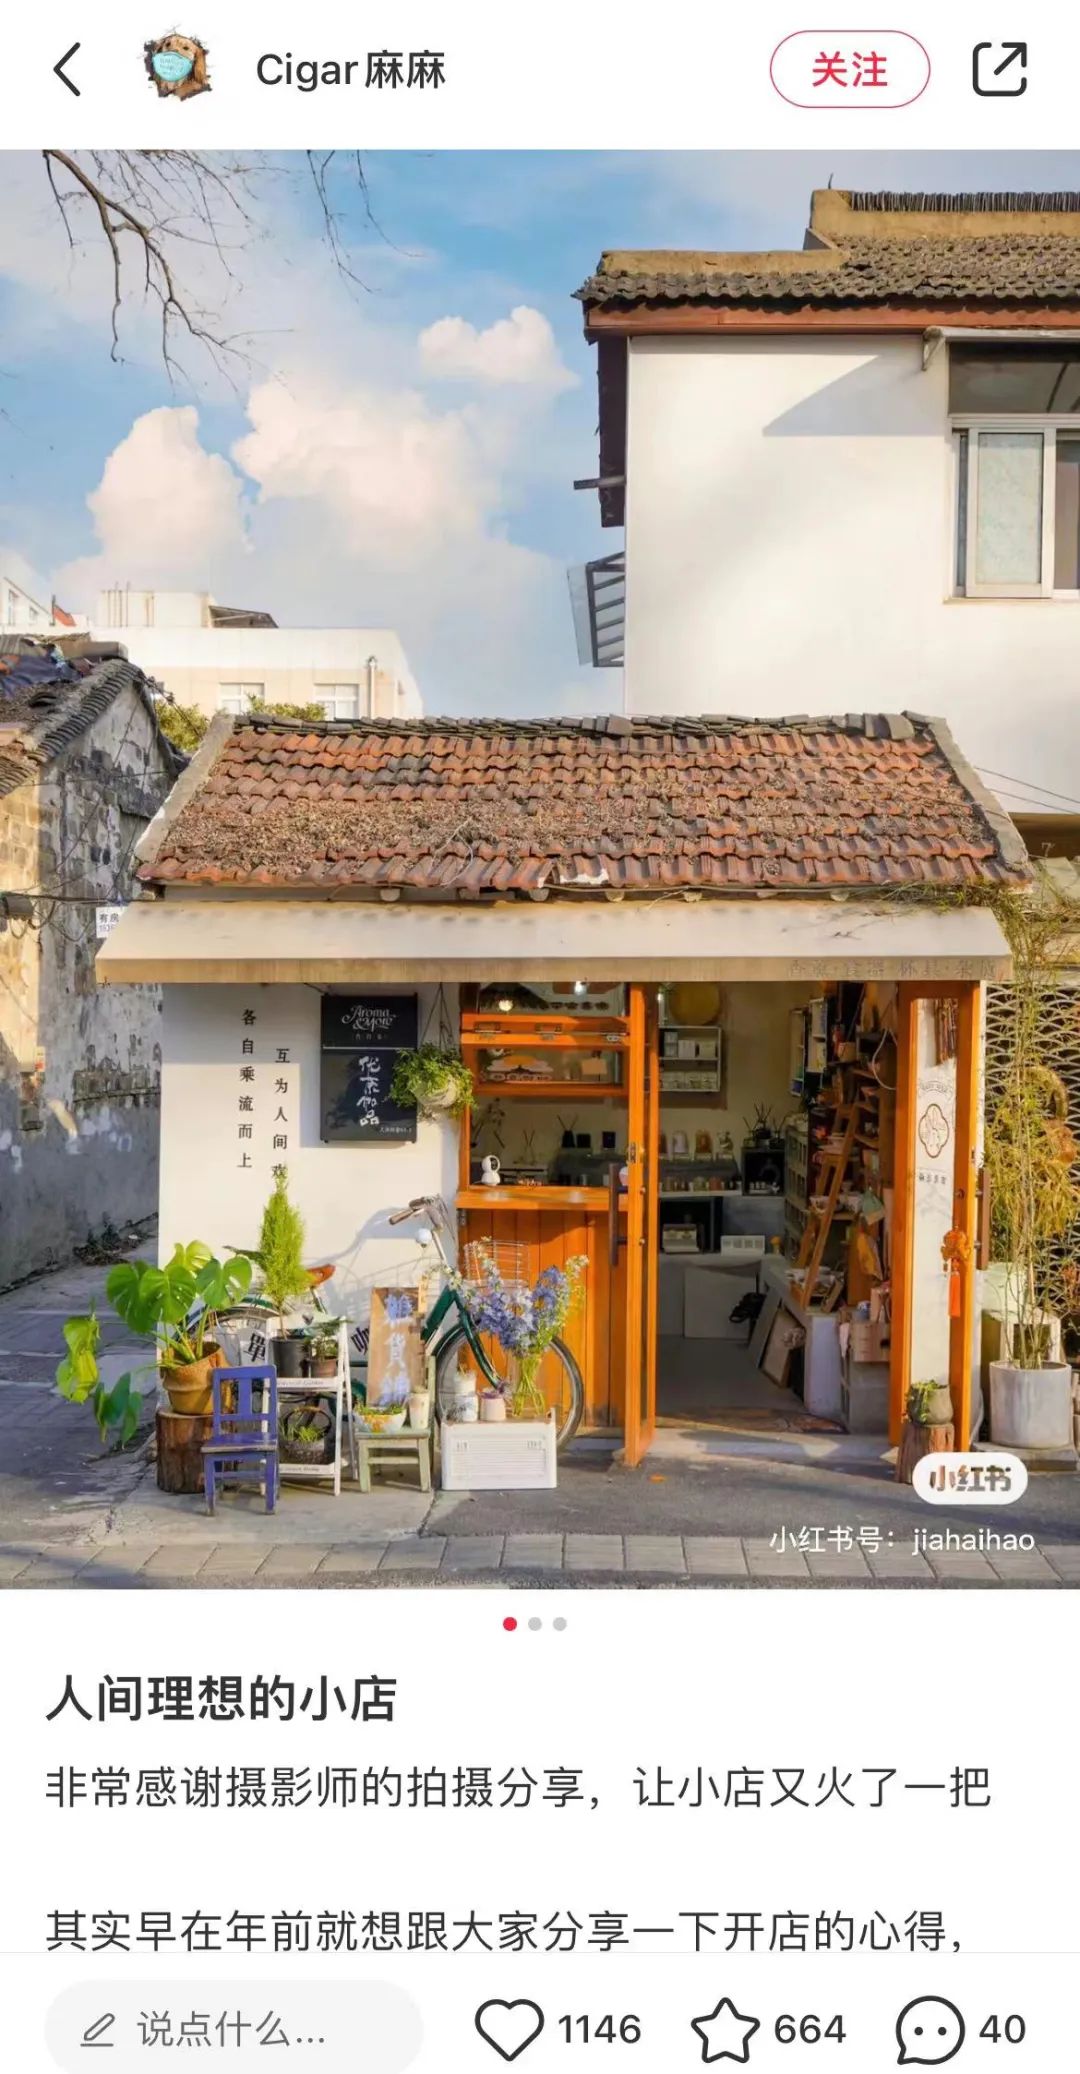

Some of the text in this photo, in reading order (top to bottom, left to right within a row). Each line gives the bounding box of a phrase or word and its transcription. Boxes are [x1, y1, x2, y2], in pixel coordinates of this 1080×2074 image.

[237, 1009, 257, 1169] 各自乘流而上
